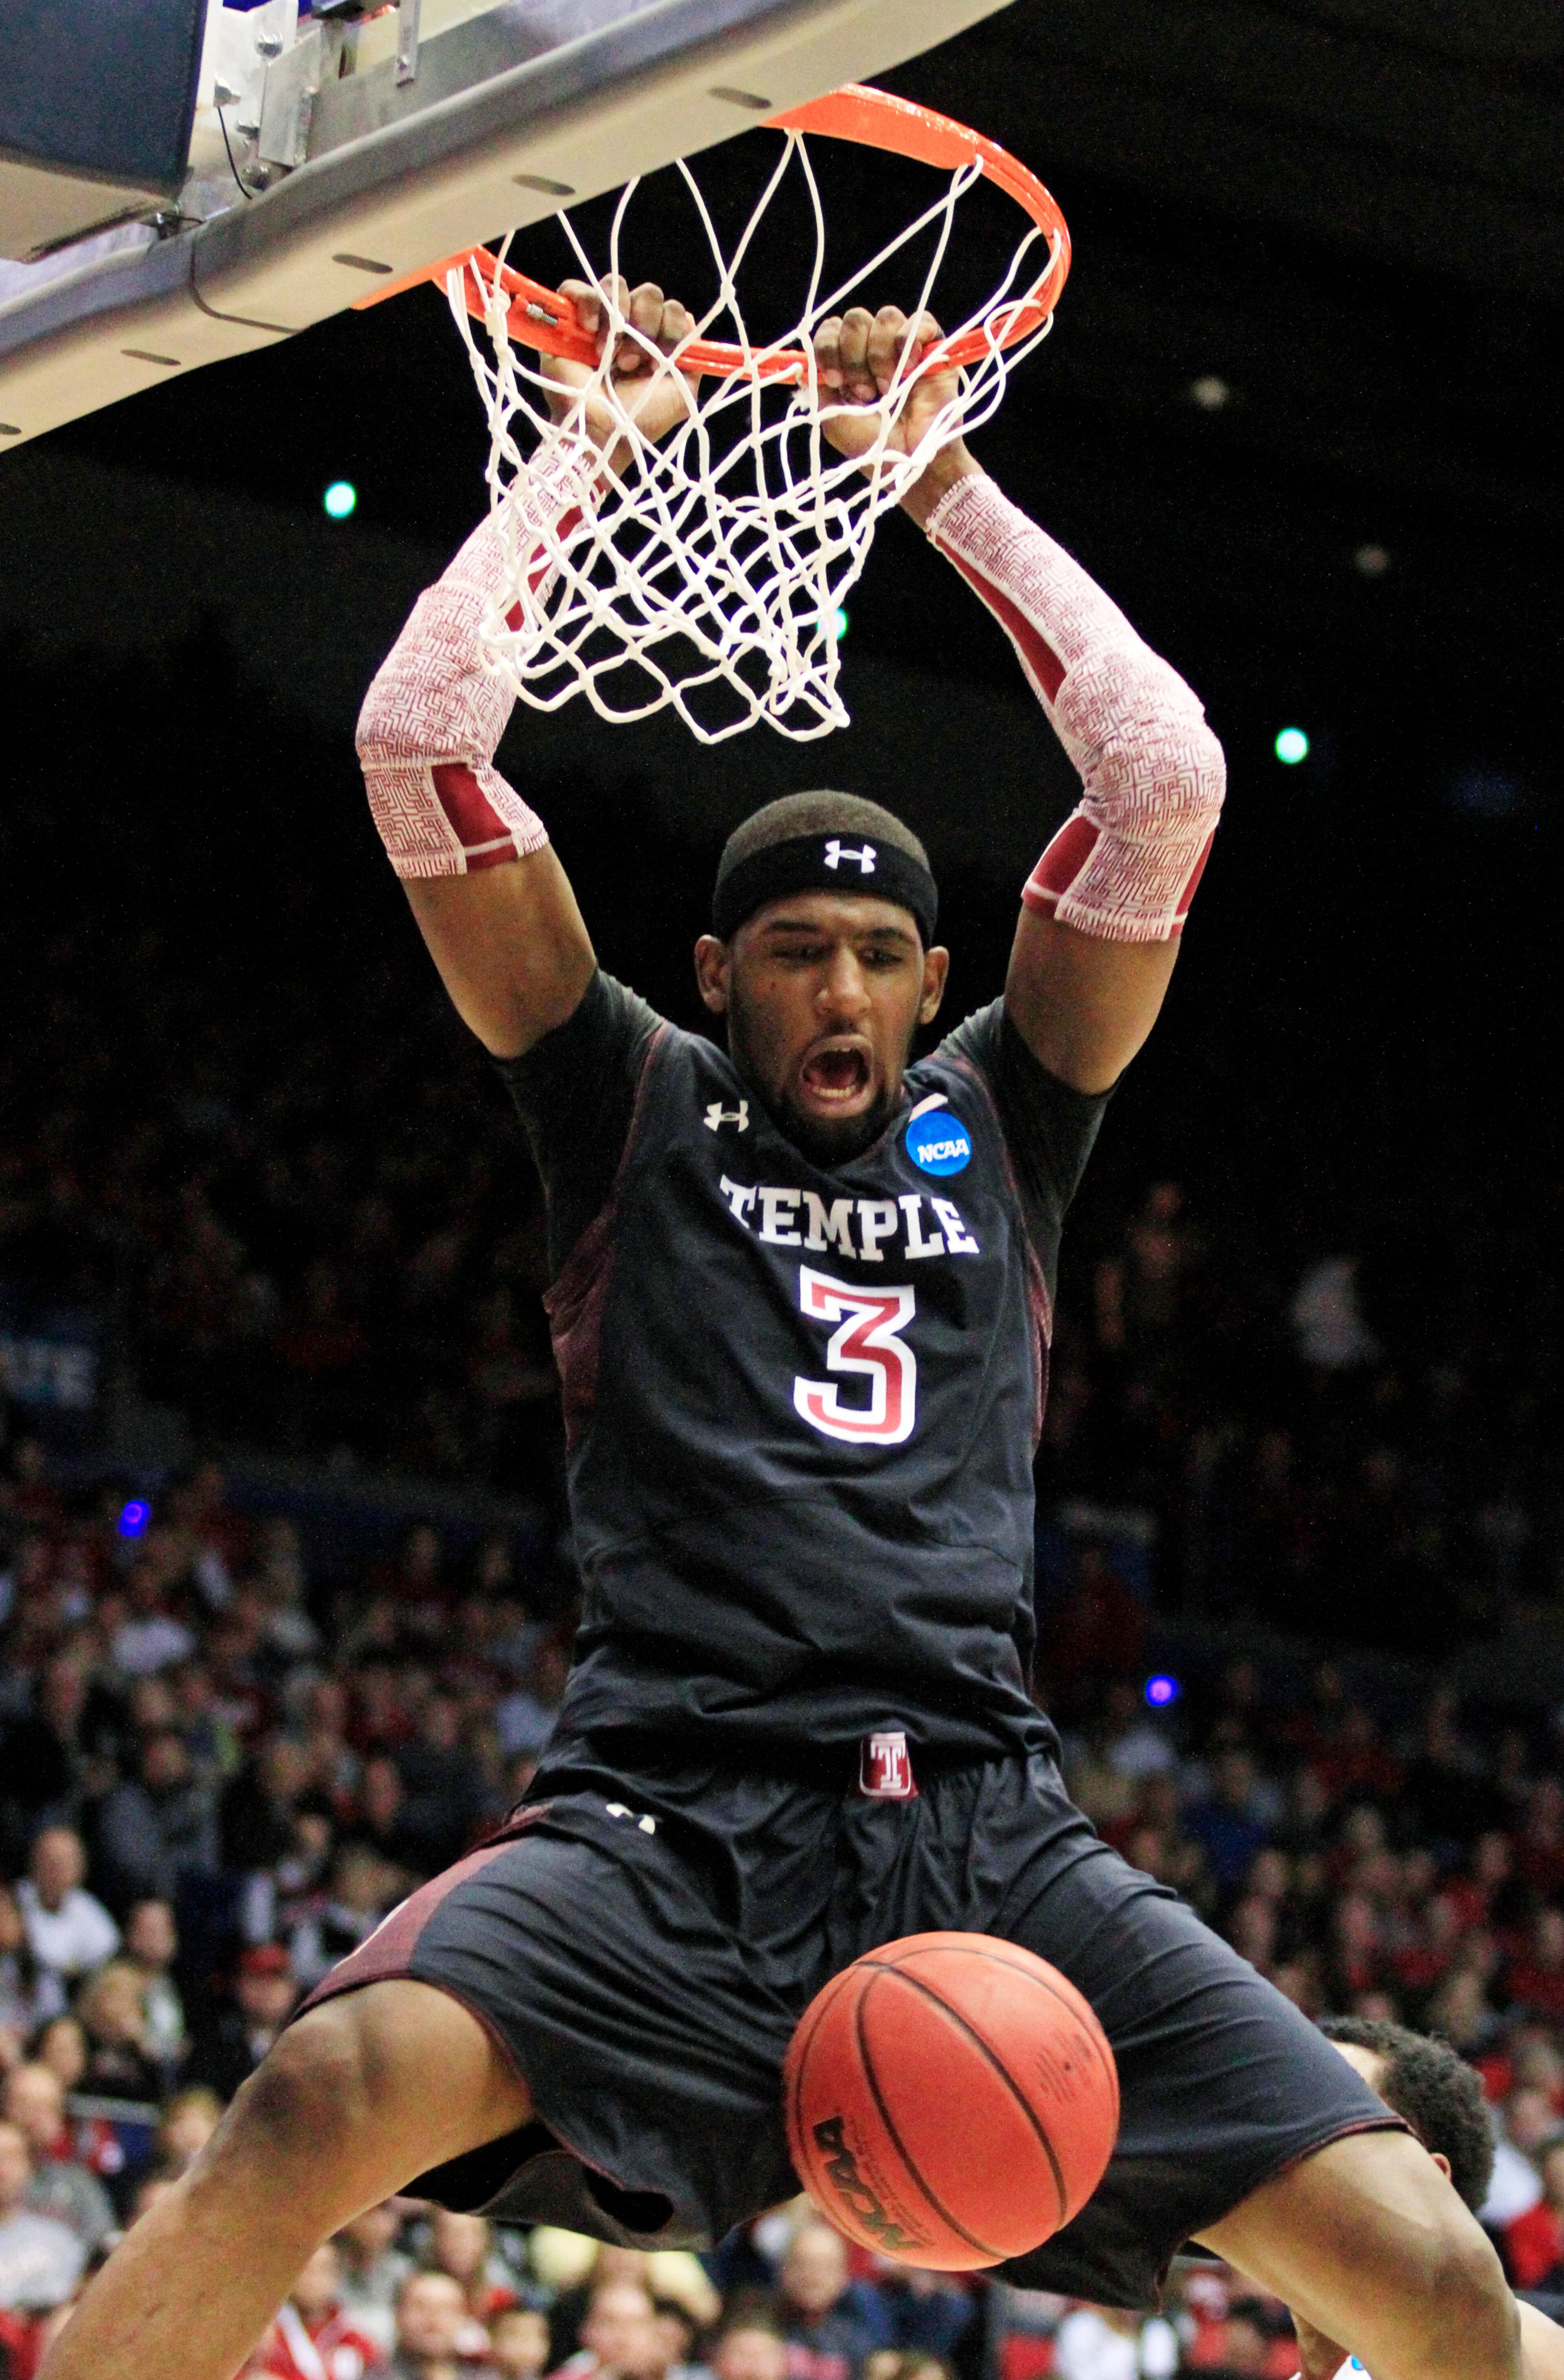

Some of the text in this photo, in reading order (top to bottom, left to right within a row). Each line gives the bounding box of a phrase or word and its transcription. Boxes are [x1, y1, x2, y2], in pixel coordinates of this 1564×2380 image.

[917, 1138, 970, 1163] NCAA
[720, 1174, 979, 1262] TEMPLE
[793, 1264, 916, 1444] 3
